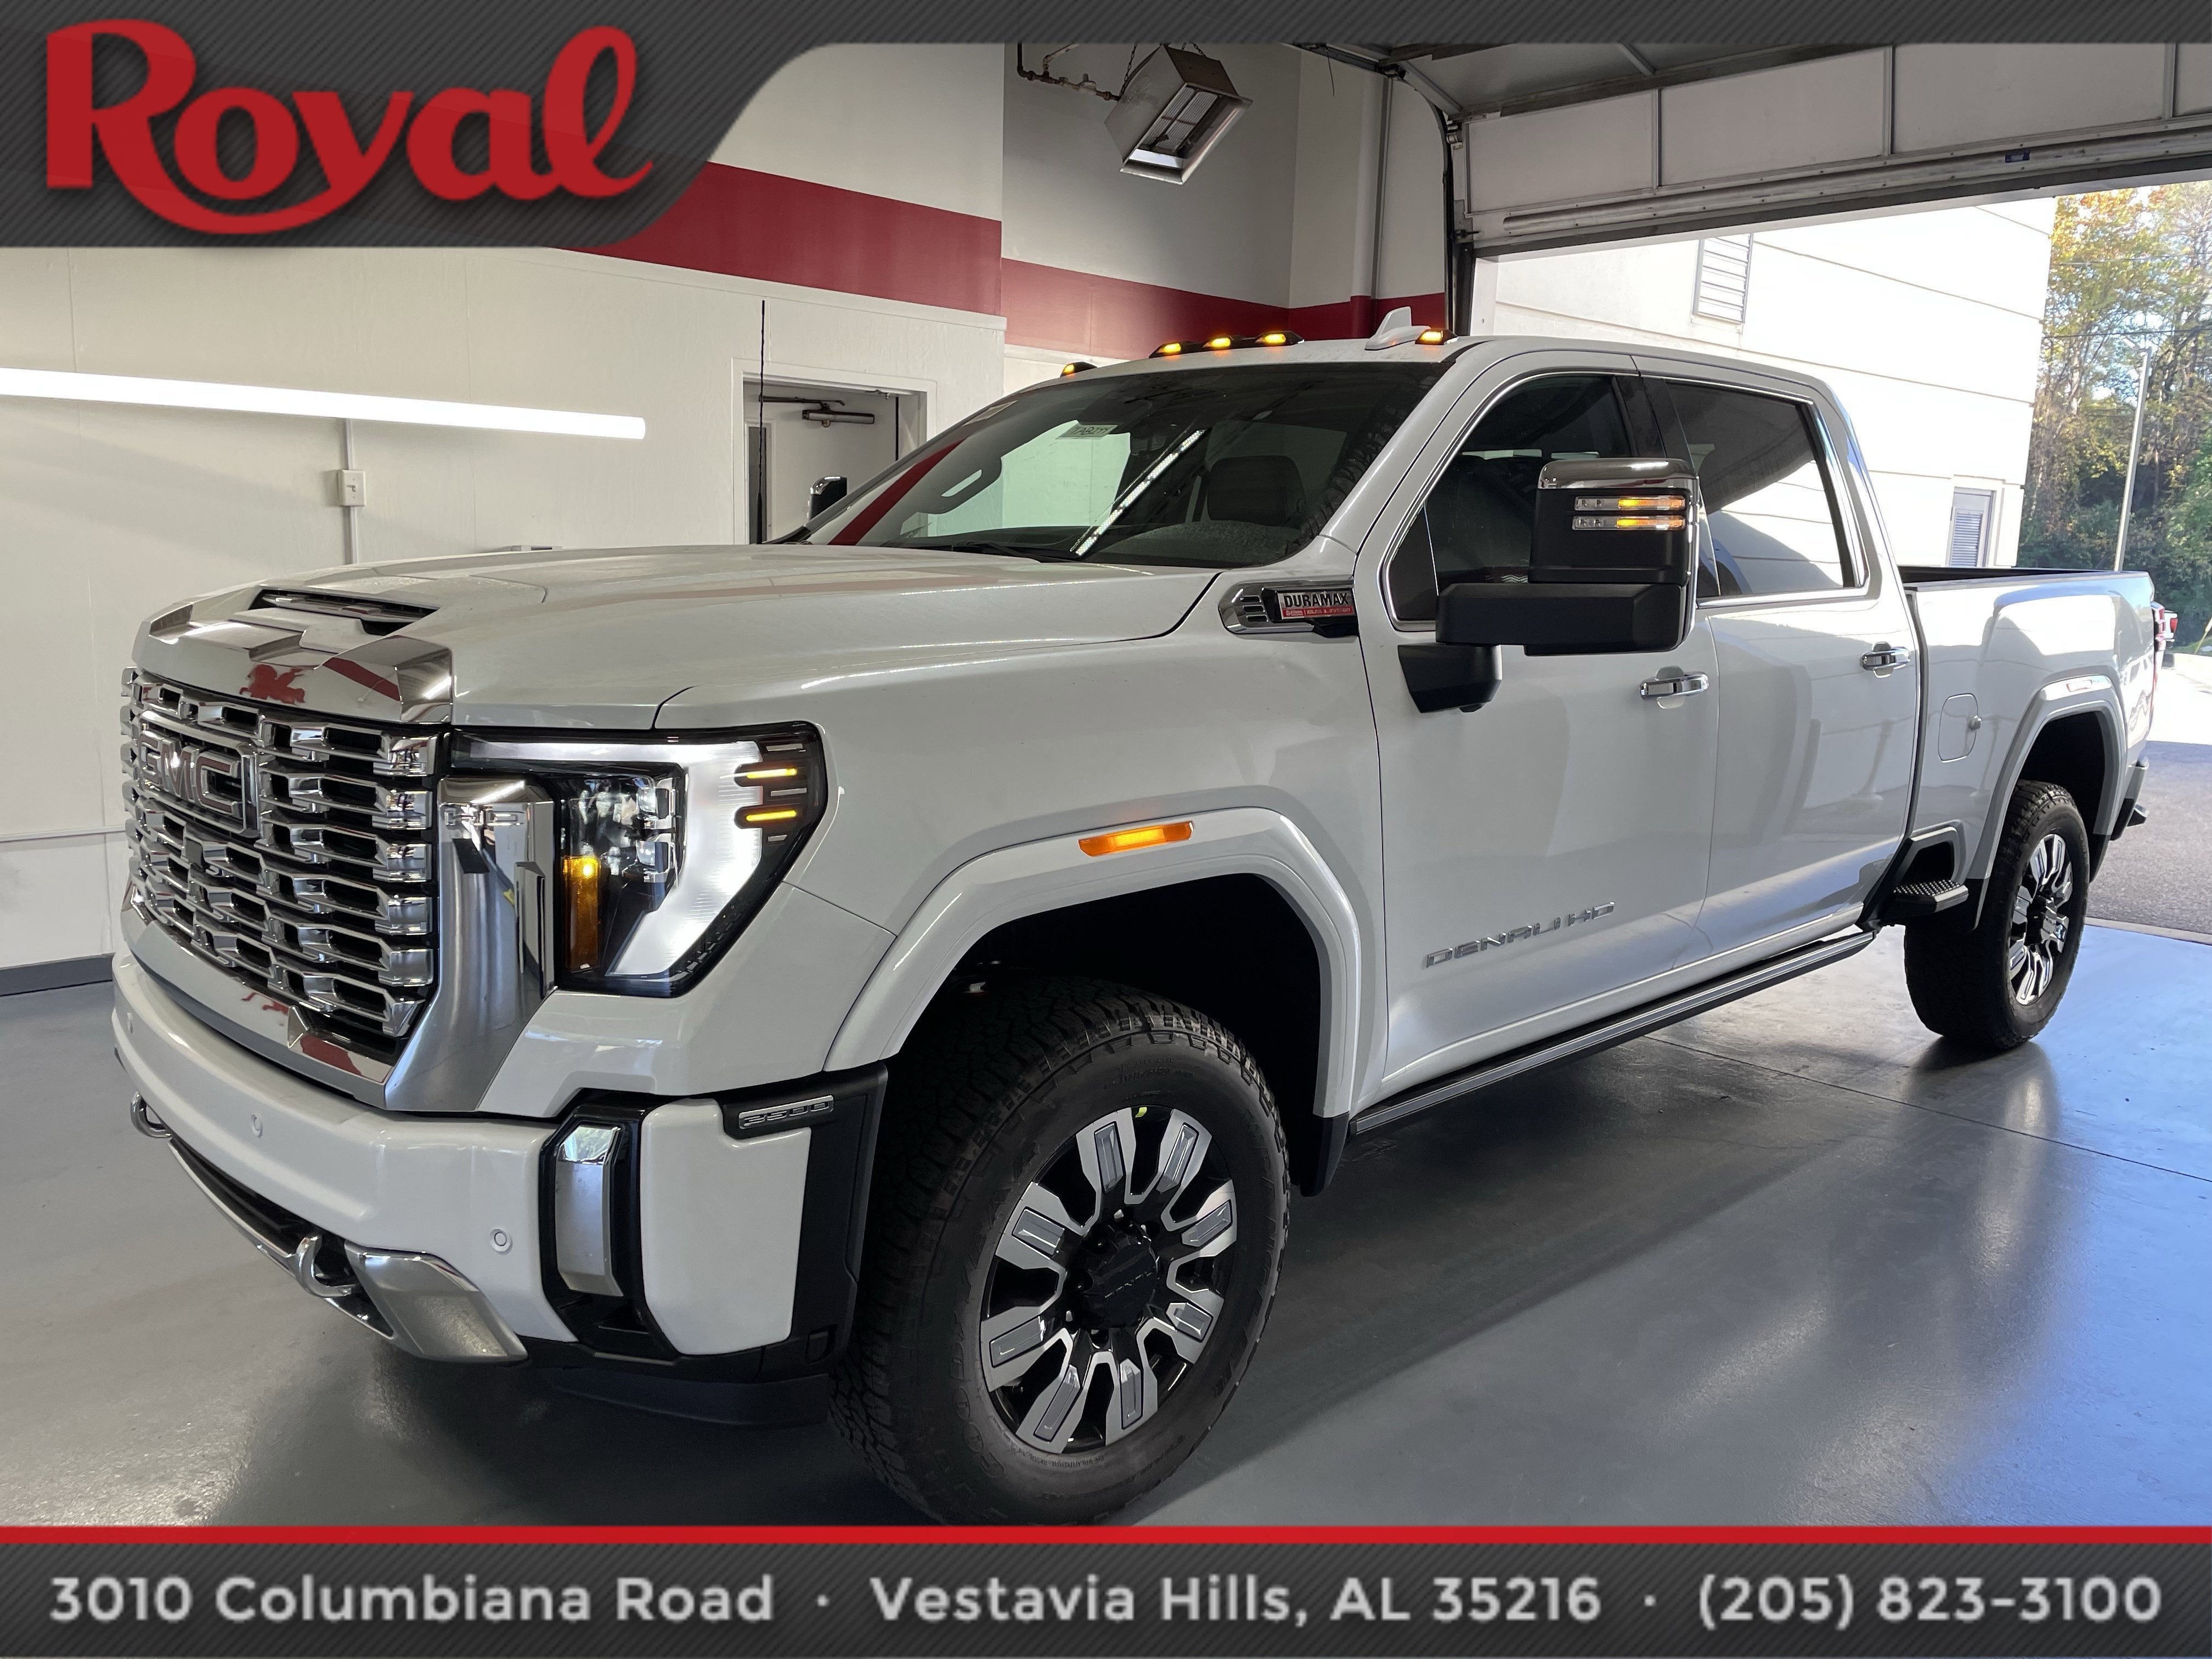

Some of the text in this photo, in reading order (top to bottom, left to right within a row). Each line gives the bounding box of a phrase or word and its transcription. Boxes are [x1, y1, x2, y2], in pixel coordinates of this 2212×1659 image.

[1283, 592, 1349, 607] DURAMAX
[139, 730, 240, 816] GMC
[1426, 901, 1615, 968] DENALI HD
[740, 1096, 833, 1128] 2500
